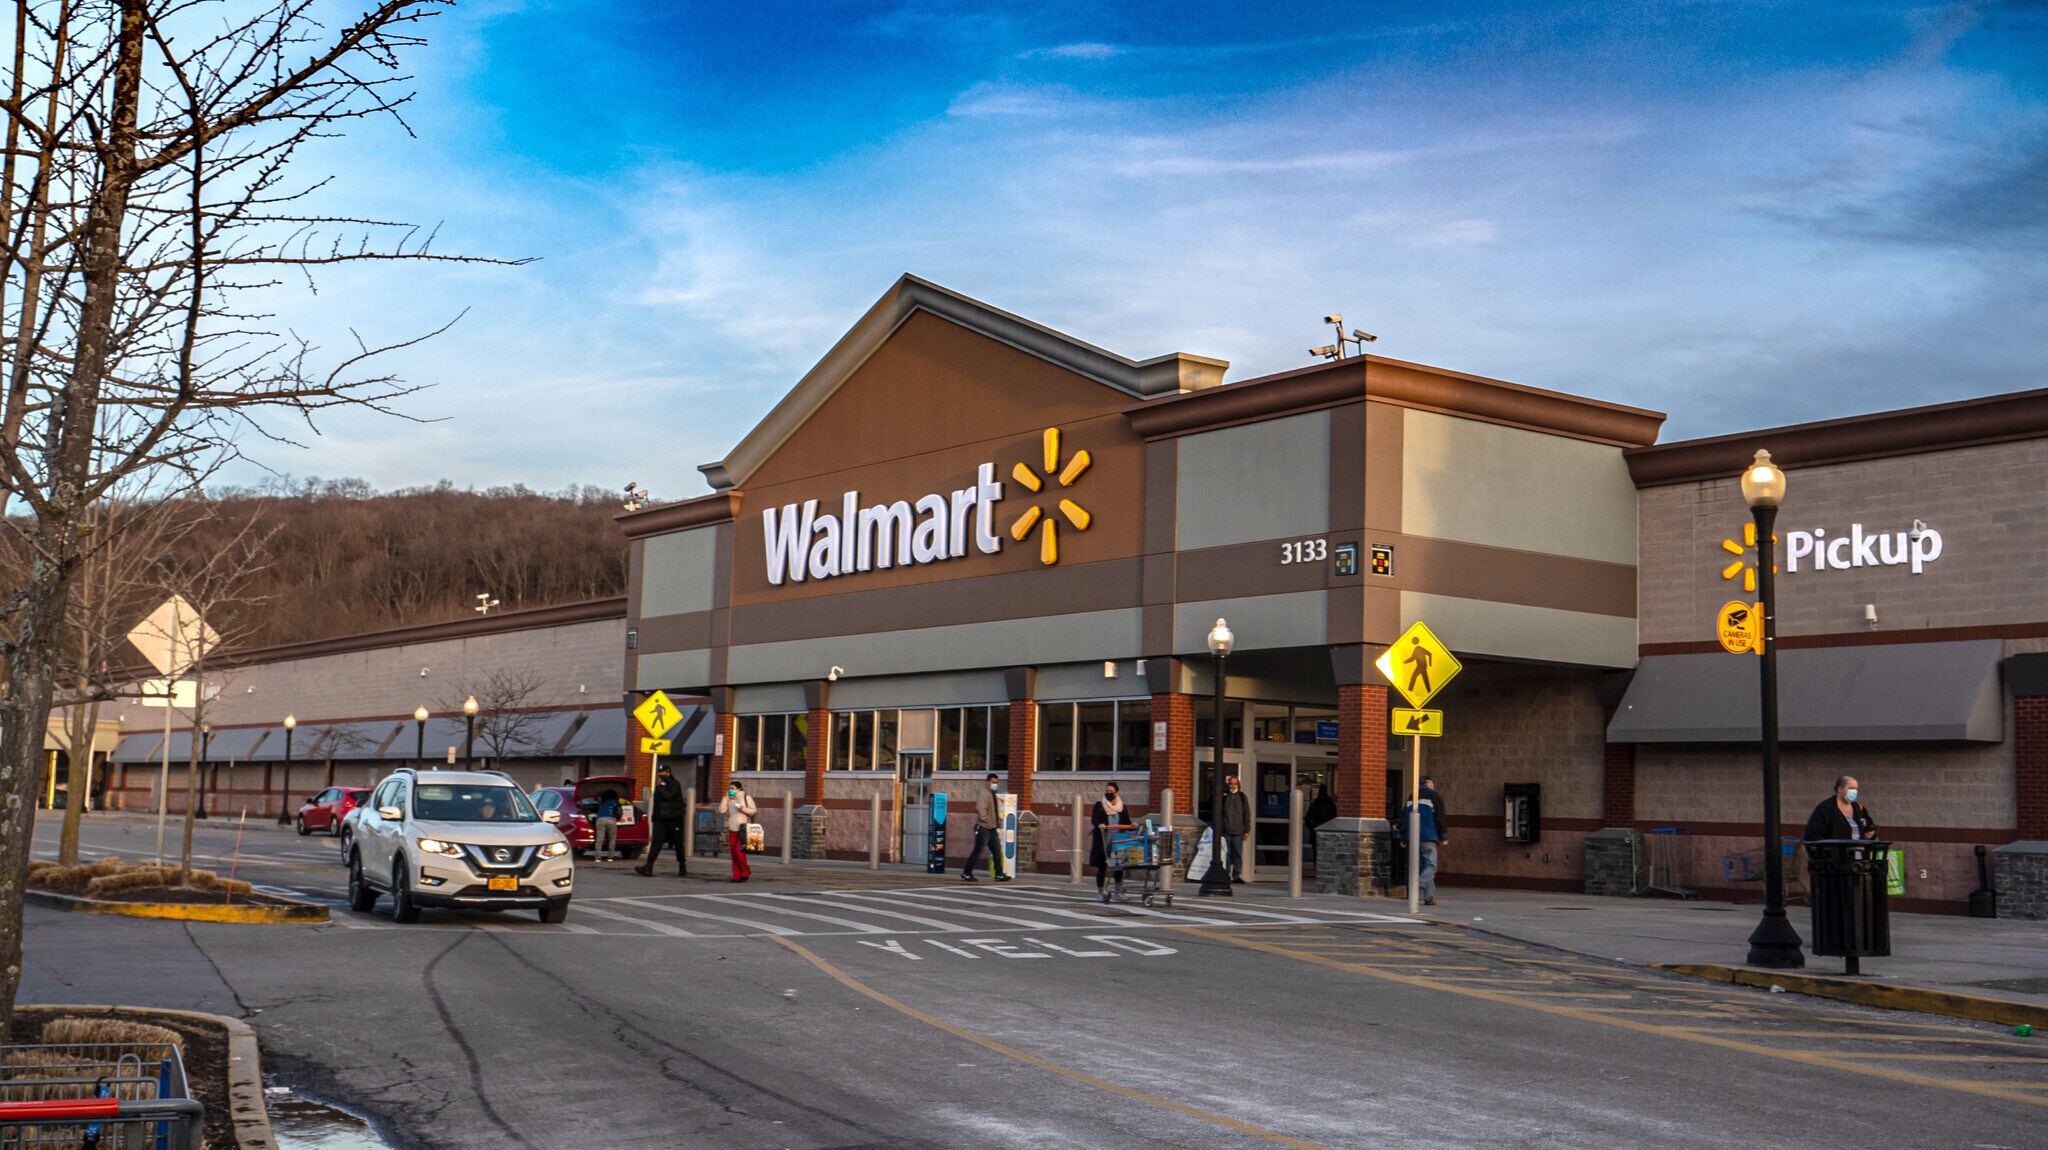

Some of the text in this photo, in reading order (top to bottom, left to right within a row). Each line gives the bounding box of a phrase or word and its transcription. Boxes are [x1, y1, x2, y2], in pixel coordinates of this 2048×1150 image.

[763, 462, 1004, 586] Walmart
[1280, 538, 1328, 566] 3133
[1786, 523, 1943, 574] Pickup
[1723, 630, 1752, 640] CAMERAS
[1736, 639, 1747, 647] USE
[856, 935, 1178, 960] YIELD
